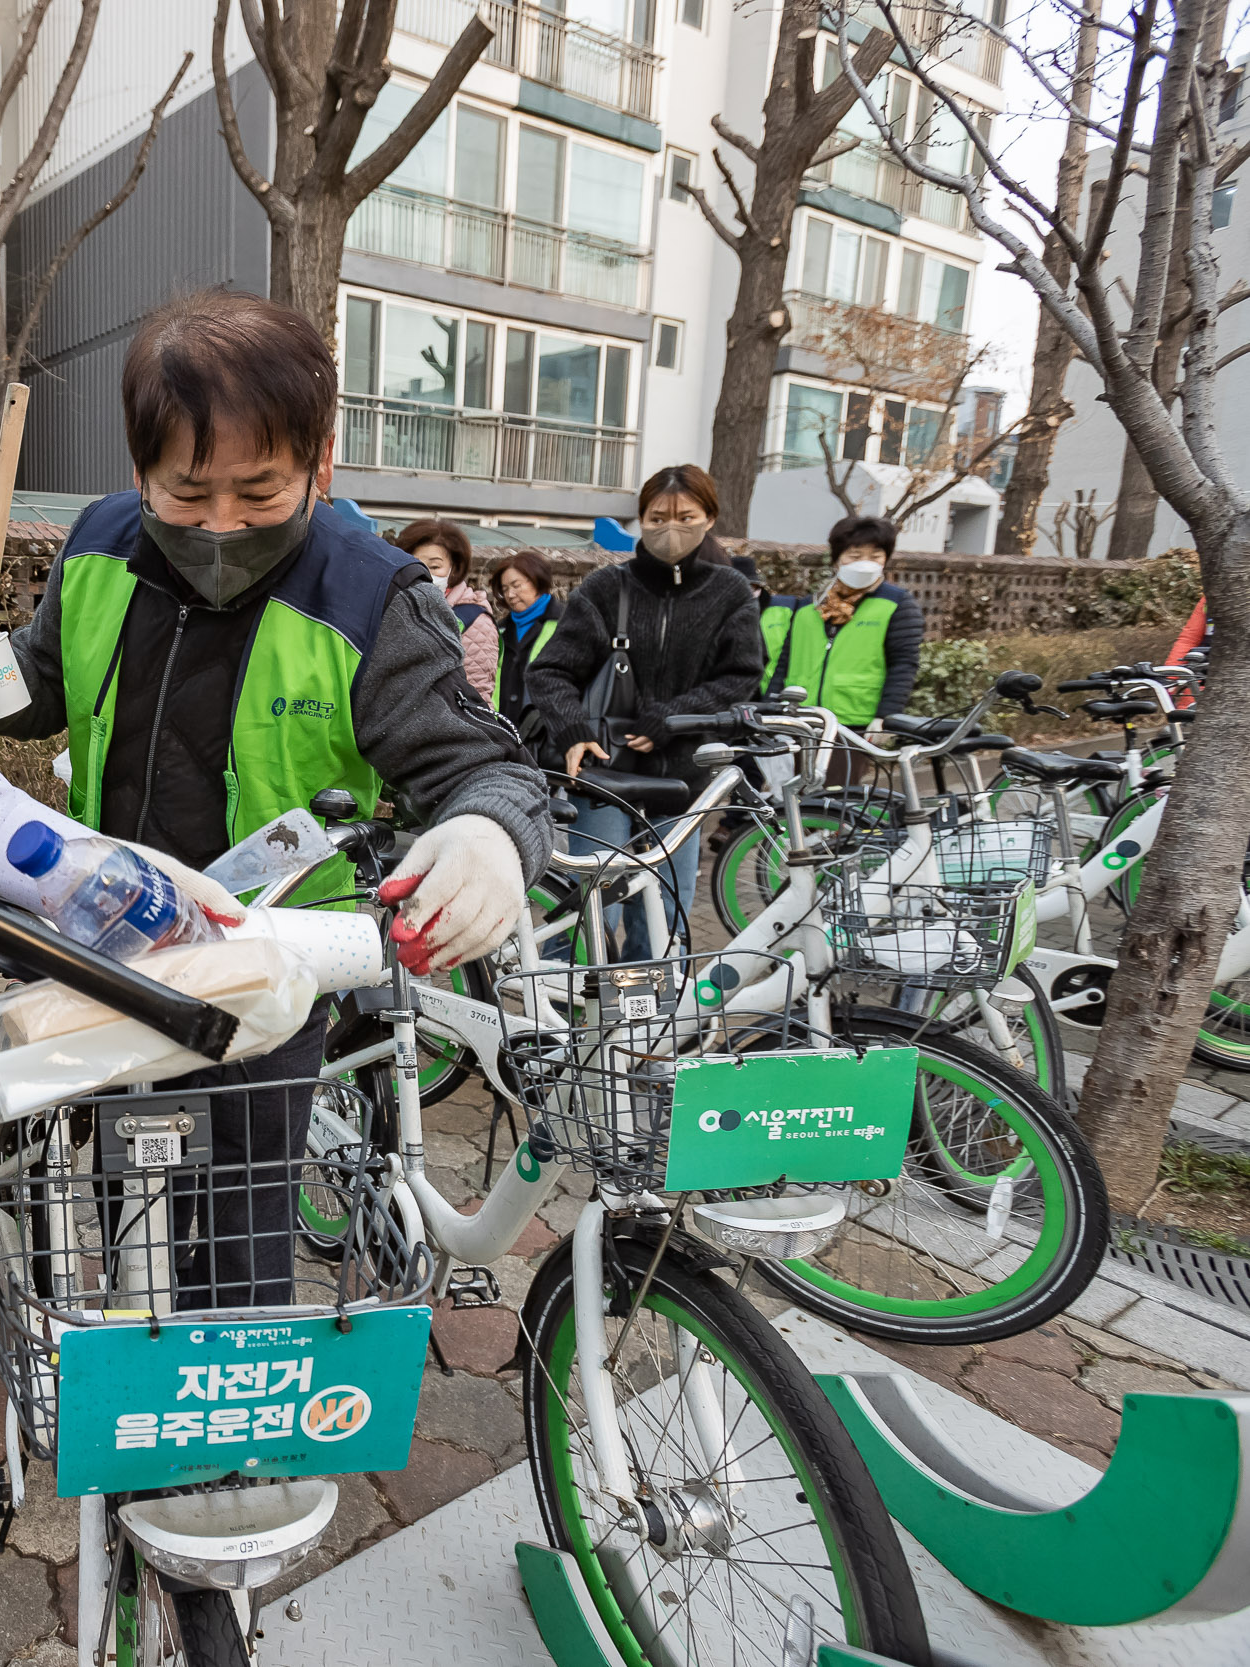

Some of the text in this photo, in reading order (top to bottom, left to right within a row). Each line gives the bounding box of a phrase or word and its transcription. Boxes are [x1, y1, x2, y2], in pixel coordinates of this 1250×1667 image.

[4, 670, 18, 681] us
[290, 699, 335, 713] 광진구
[469, 1009, 497, 1027] 37014
[743, 1106, 854, 1140] 서울자전거
[785, 1125, 885, 1141] SEOUL BIKE 따릉이
[219, 1327, 292, 1349] 서울자전거
[176, 1357, 315, 1402] 자전거
[114, 1396, 365, 1451] 음주운전 NO
[240, 1540, 259, 1554] LED
